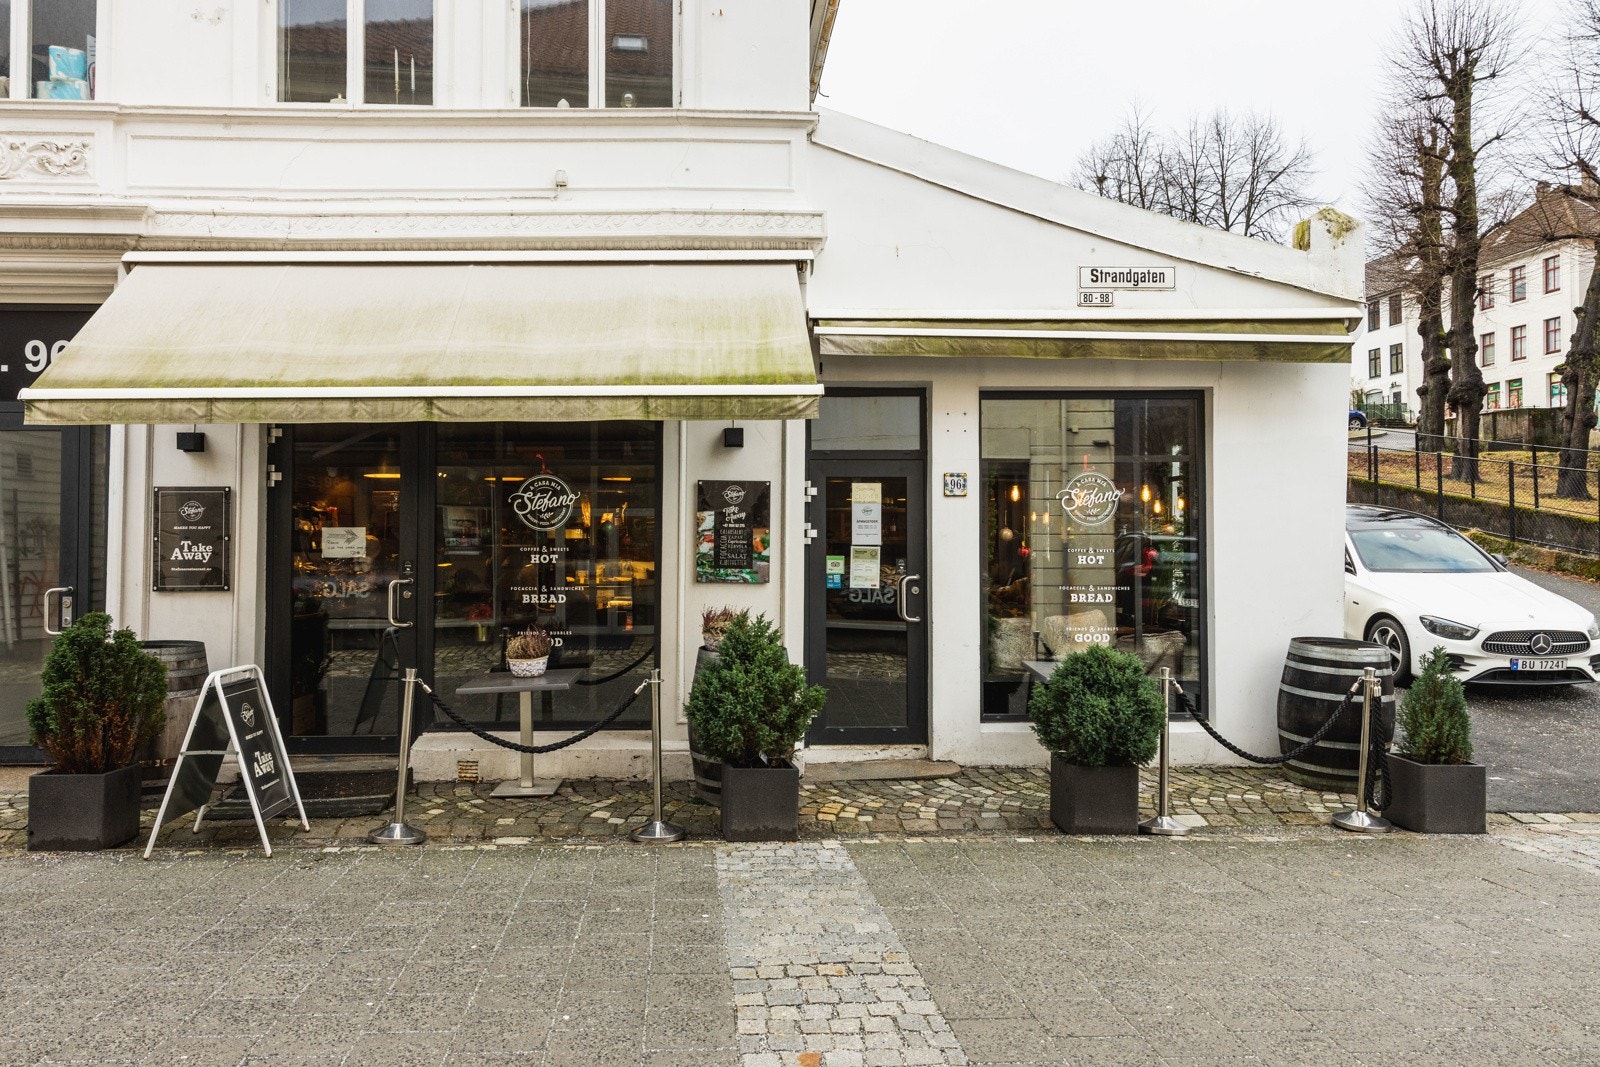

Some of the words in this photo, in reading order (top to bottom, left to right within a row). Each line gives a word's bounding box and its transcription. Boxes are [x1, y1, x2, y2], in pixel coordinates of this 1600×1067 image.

[1090, 268, 1165, 287] Strandgaten
[551, 481, 561, 491] MIA
[950, 479, 962, 490] 96
[722, 489, 747, 499] Stefano
[1055, 487, 1126, 511] Stefano
[507, 490, 581, 515] Stefano
[178, 506, 207, 516] Stefano
[722, 505, 740, 516] Take
[725, 512, 747, 523] Away
[180, 540, 213, 552] Take
[541, 545, 548, 553] &
[170, 548, 212, 563] Away
[530, 554, 559, 564] HOT
[1077, 555, 1105, 565] HOT
[1088, 584, 1095, 592] &
[522, 594, 567, 604] BREAD
[1070, 593, 1113, 603] BREAD
[1074, 633, 1111, 643] GOOD
[1521, 660, 1535, 669] BU
[1539, 660, 1564, 669] 17241
[254, 750, 273, 766] Take
[253, 759, 275, 778] Away
